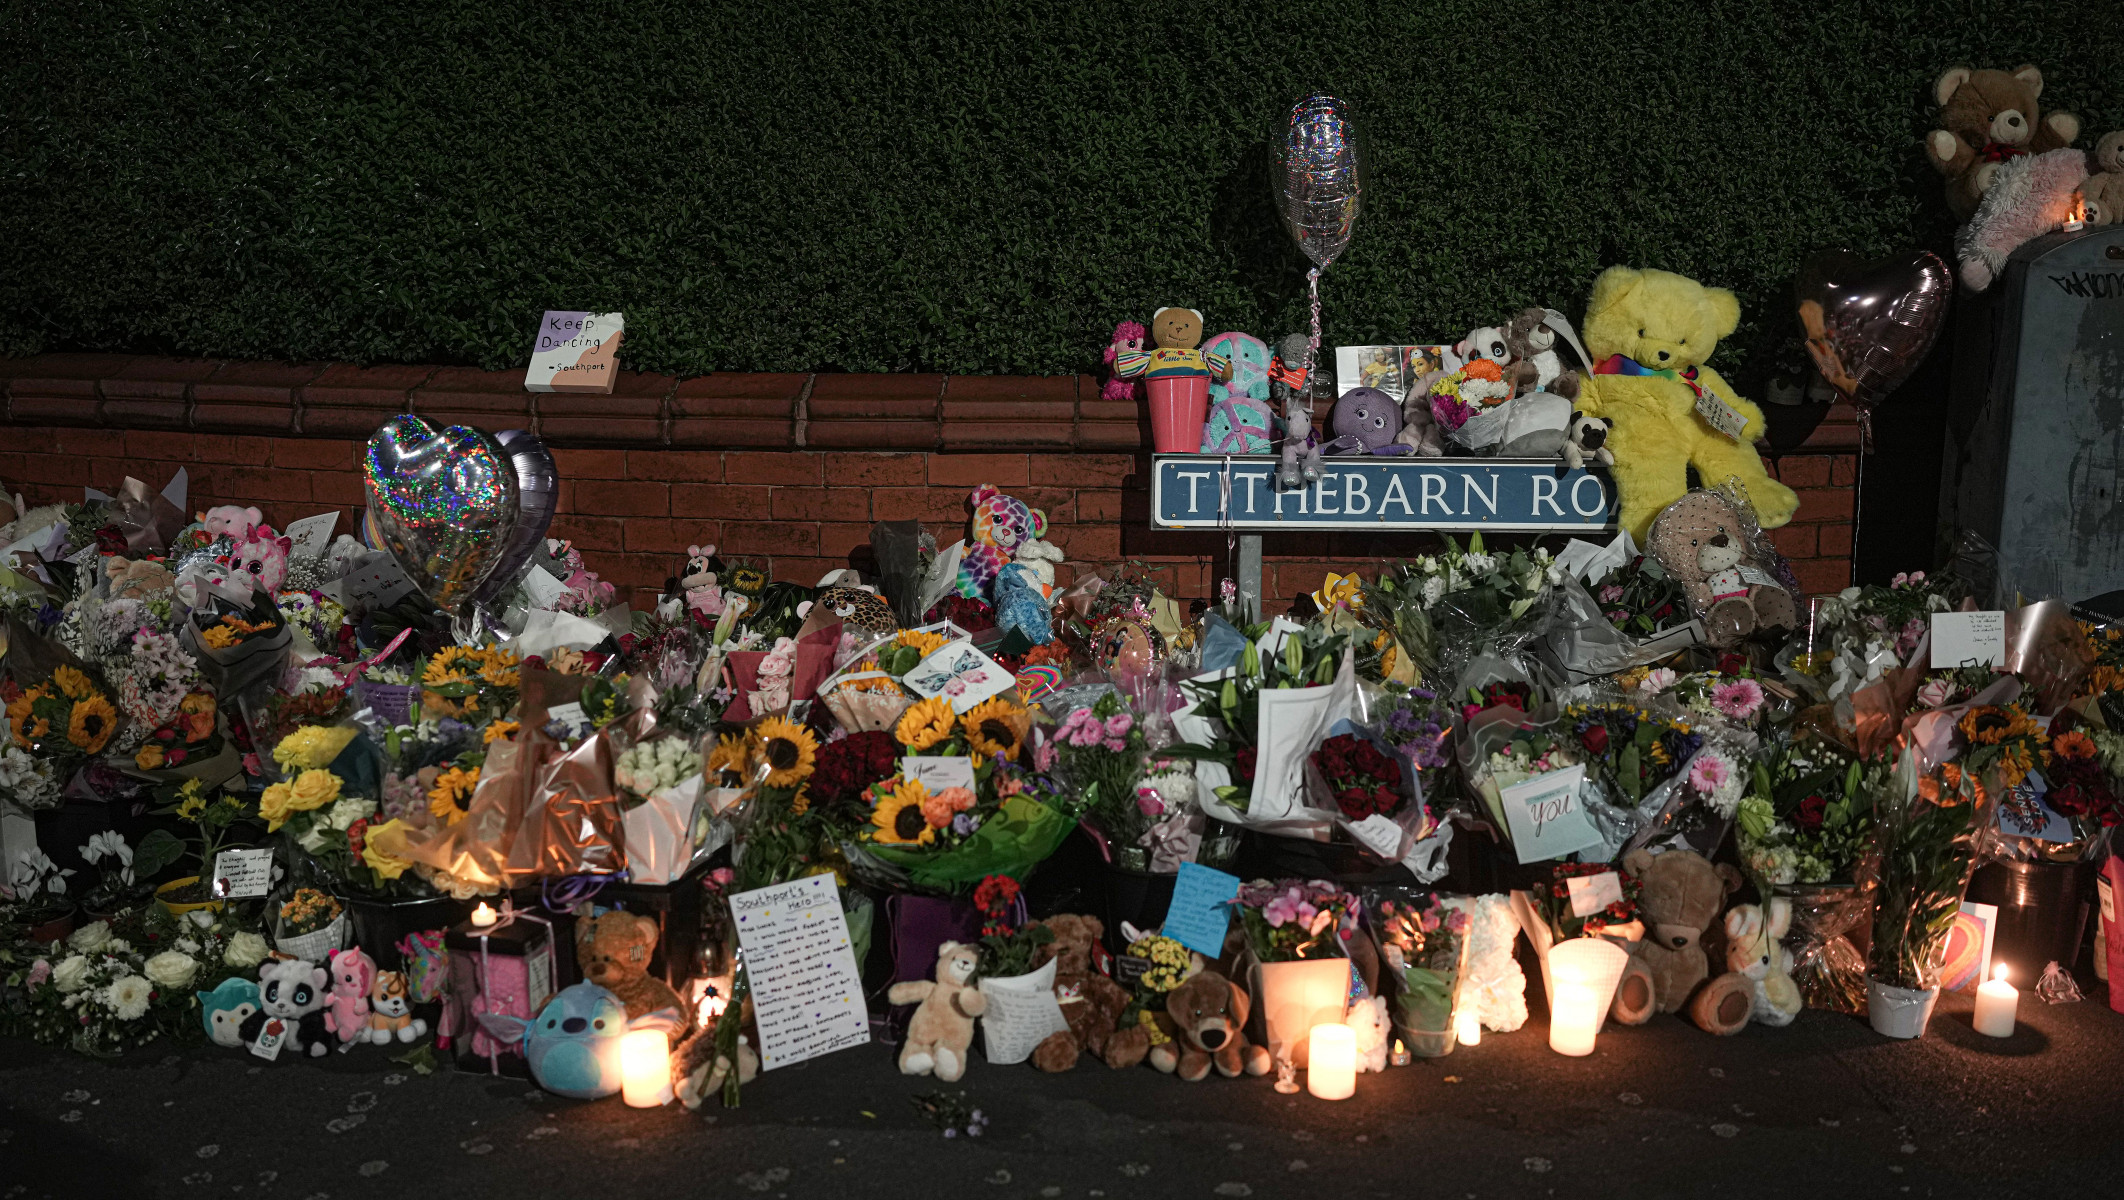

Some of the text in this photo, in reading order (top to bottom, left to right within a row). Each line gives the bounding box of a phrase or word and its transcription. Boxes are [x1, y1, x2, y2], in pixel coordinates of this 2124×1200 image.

[550, 318, 594, 331] Keep
[541, 335, 601, 354] Dancing
[1177, 471, 1610, 517] TITHEBARN RO
[2012, 783, 2033, 825] SENDI
[2023, 785, 2043, 815] LOVE
[737, 886, 805, 907] Southport's
